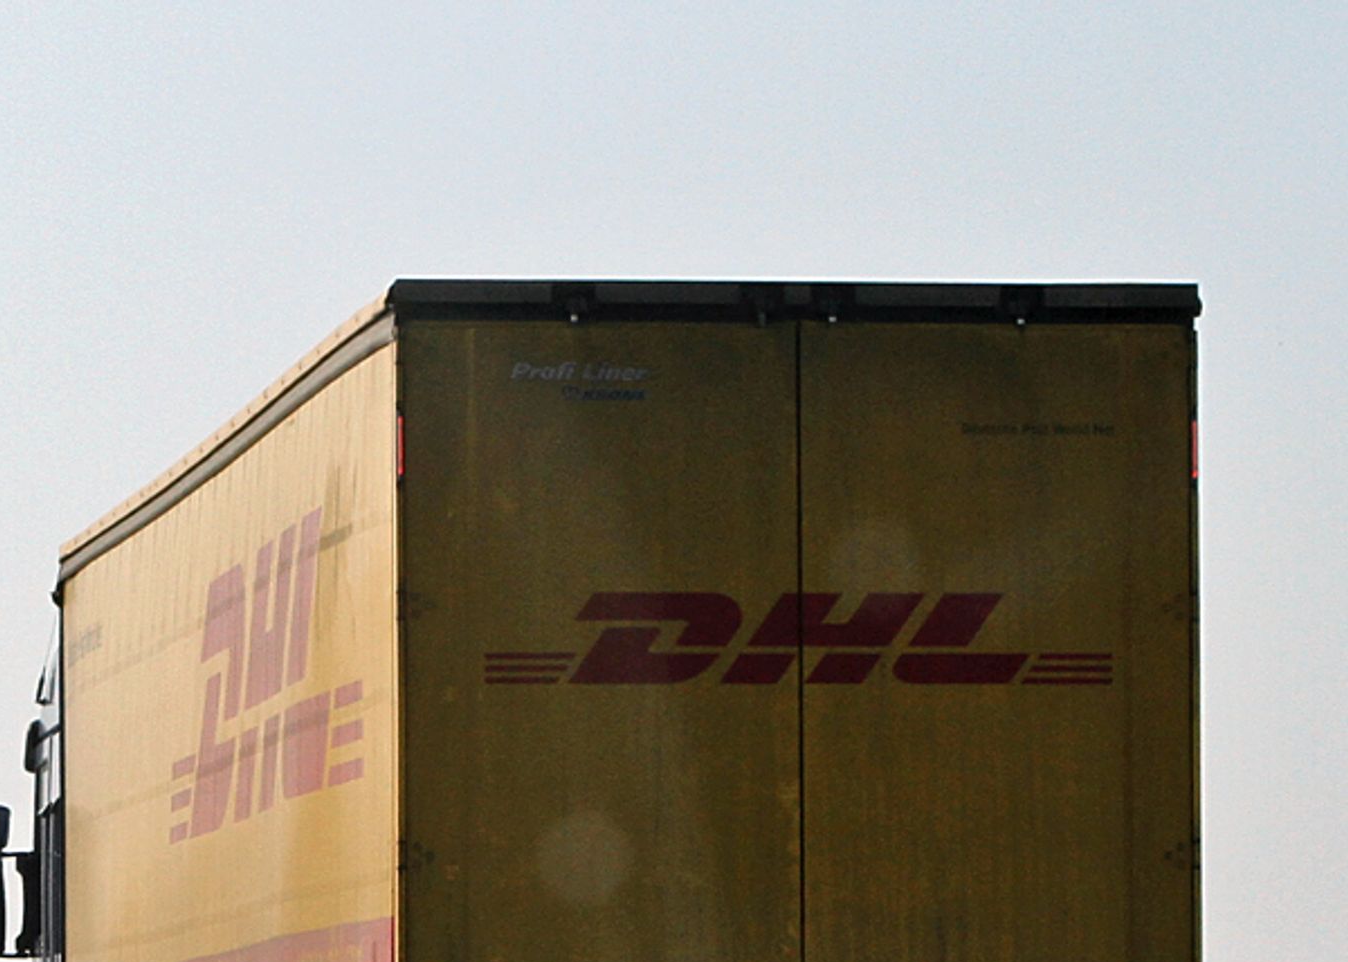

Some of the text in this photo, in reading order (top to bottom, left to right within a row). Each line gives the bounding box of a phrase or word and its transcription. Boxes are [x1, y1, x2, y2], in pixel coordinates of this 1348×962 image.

[510, 360, 649, 381] Profi Liner
[189, 505, 322, 839] DHL
[567, 591, 1032, 685] DHL
